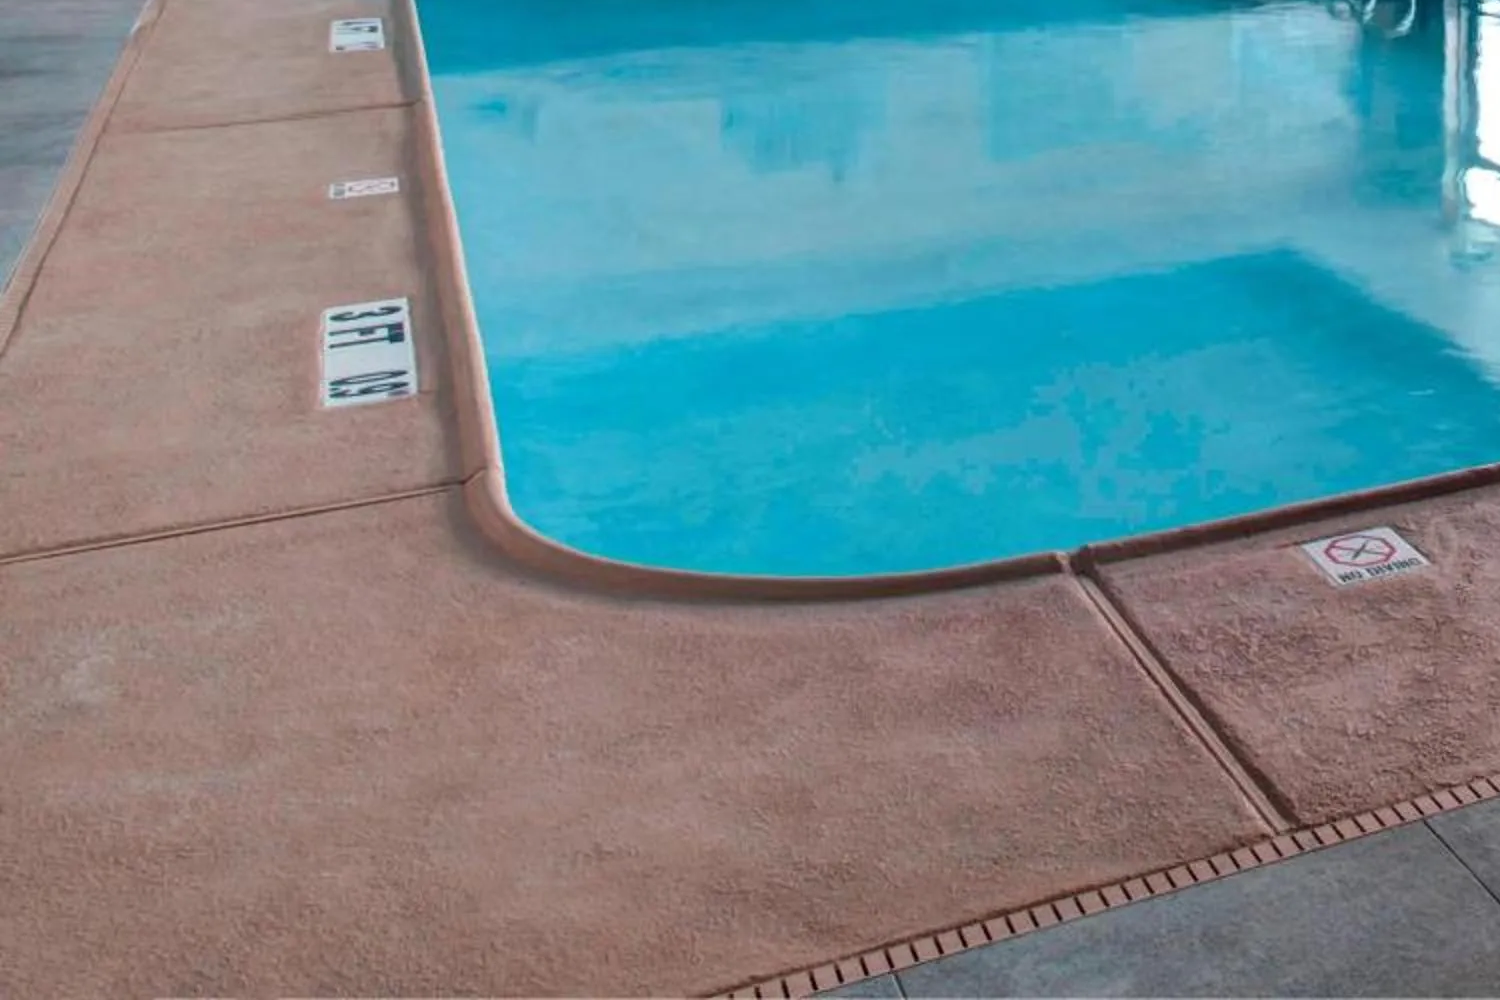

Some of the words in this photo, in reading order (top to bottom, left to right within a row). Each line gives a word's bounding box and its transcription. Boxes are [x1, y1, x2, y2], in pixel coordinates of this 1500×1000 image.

[329, 306, 402, 322] 3
[328, 321, 404, 350] FT
[1337, 571, 1362, 583] NO
[1366, 557, 1423, 577] DIVING
